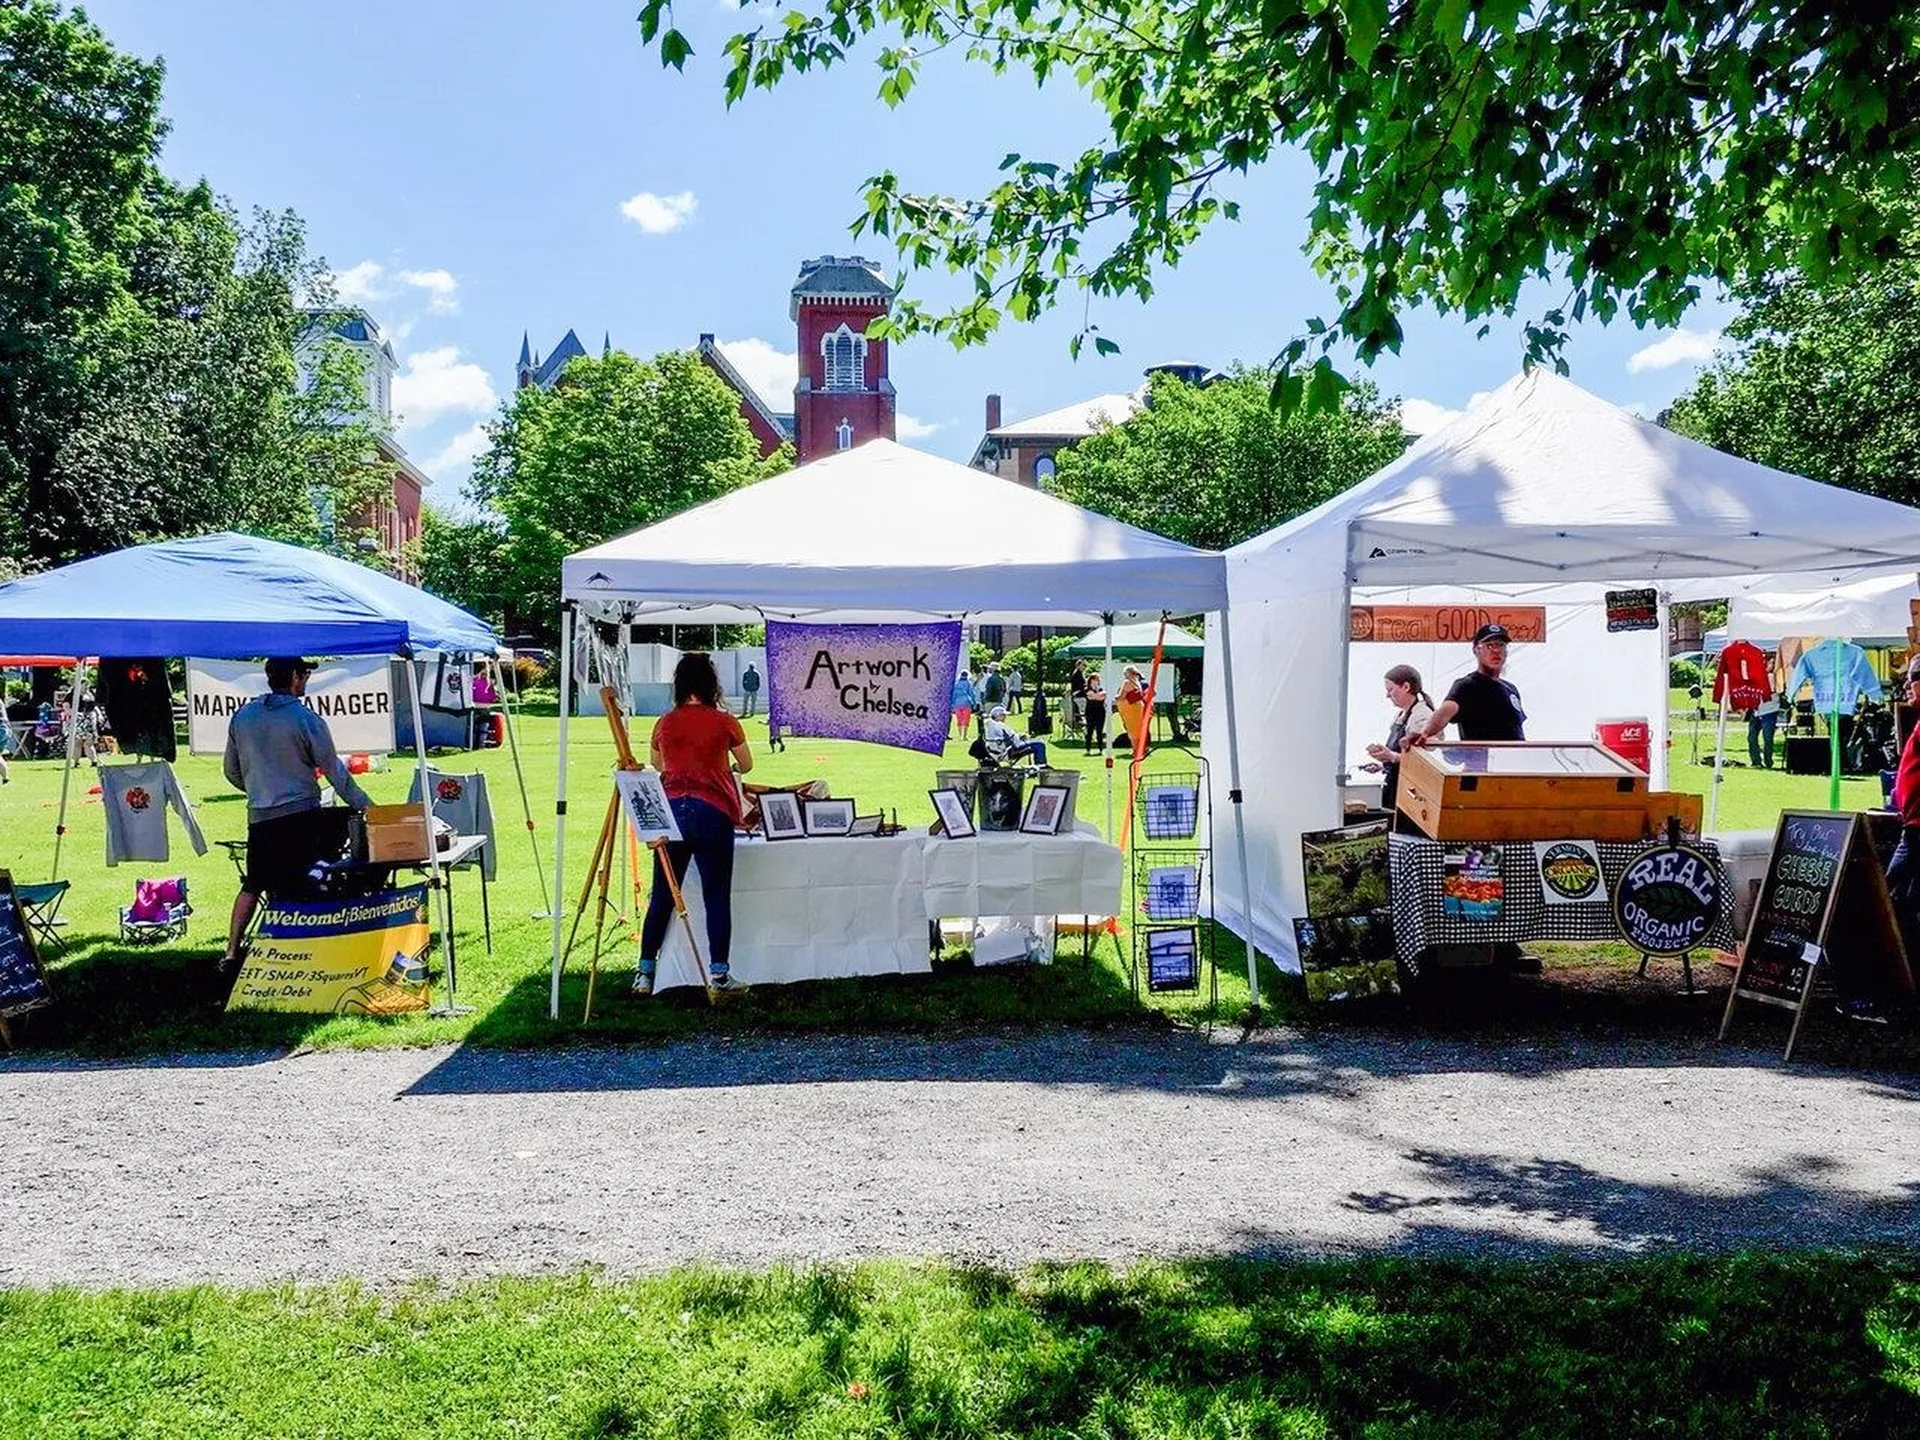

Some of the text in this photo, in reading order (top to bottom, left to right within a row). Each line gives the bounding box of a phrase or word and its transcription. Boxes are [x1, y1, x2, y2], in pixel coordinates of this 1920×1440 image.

[1377, 614, 1430, 642] real
[804, 646, 931, 690] Artwork
[869, 680, 881, 693] by
[194, 692, 389, 717] MARK ANAGER
[840, 684, 929, 719] Chelsea
[1620, 727, 1642, 738] ACE
[1628, 852, 1715, 905] REAL
[1777, 854, 1832, 887] CHEESE
[1773, 884, 1821, 914] CURDS
[264, 908, 344, 926] Welcome!
[1624, 902, 1704, 938] ORGANIC
[1631, 926, 1690, 949] PROJECT
[266, 948, 313, 961] Process:
